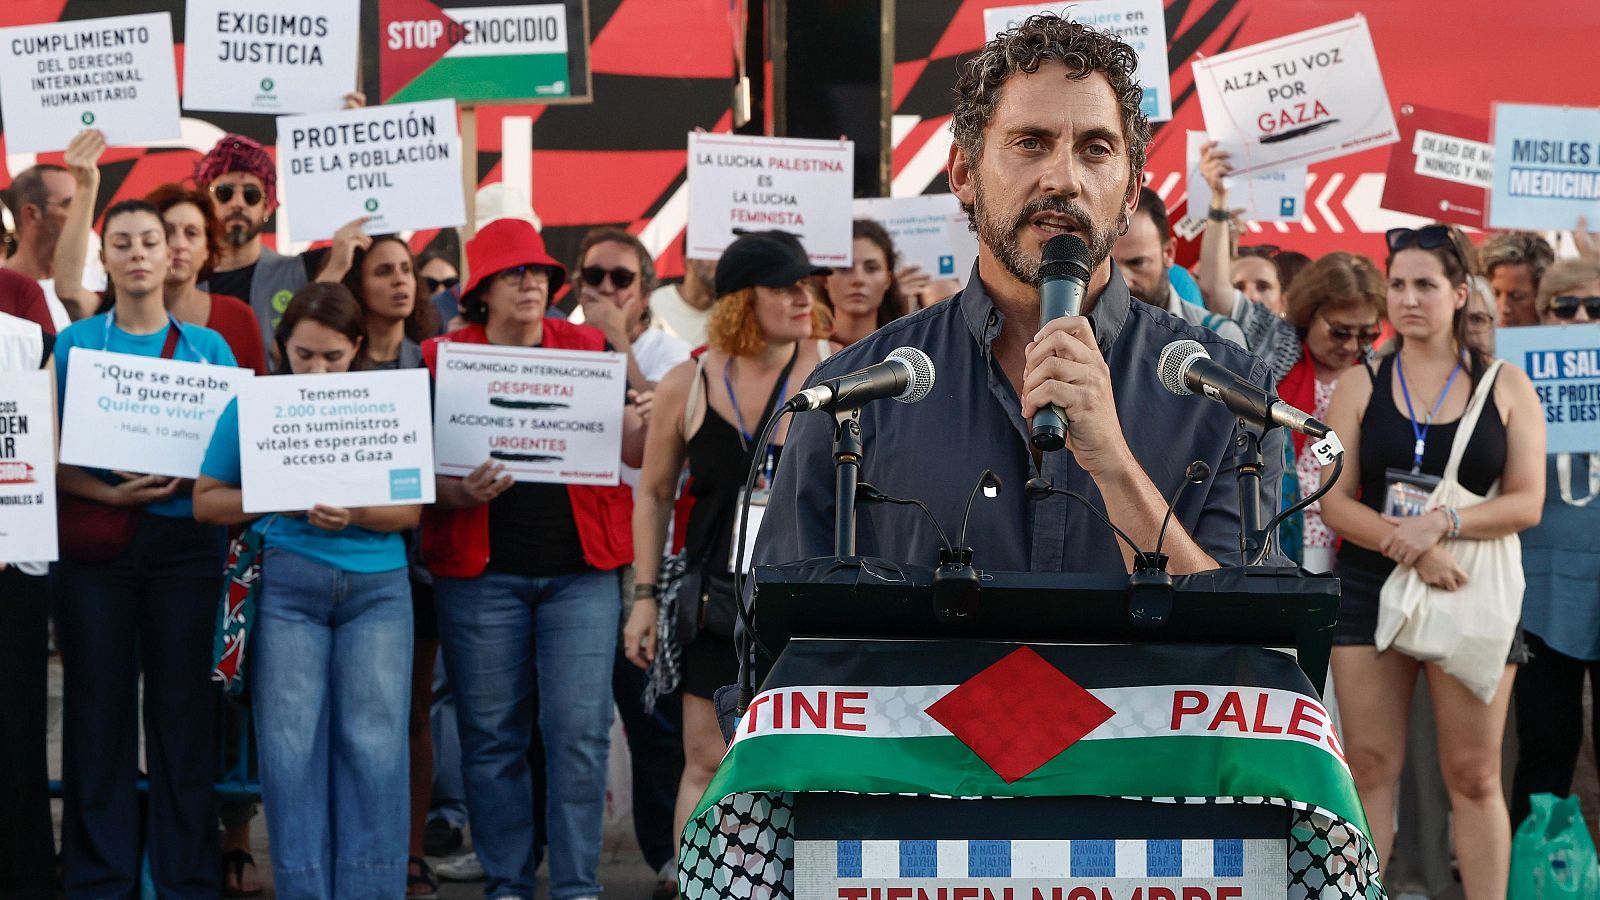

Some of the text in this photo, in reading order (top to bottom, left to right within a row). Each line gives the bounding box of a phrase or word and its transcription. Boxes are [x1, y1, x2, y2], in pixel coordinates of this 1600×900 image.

[217, 12, 328, 37] EXIGIMOS
[1126, 10, 1144, 20] en
[12, 26, 149, 56] CUMPLIMIENTO
[388, 16, 558, 50] STOP GENOCIDIO
[37, 52, 133, 73] DEL DERECHO
[218, 41, 323, 66] JUSTICIA
[31, 68, 143, 91] INTERNACIONAL
[1223, 48, 1344, 93] ALZA TU VOZ
[40, 86, 137, 108] HUMANITARIO
[1268, 81, 1307, 103] POR
[1258, 100, 1330, 133] GAZA
[293, 110, 436, 150] PROTECCIÓN
[291, 139, 449, 174] DE LA POBLACIÓN
[1462, 146, 1476, 160] DE
[1512, 140, 1590, 164] MISILES
[696, 153, 844, 173] LA LUCHA PALESTINA
[347, 172, 393, 190] CIVIL
[757, 175, 774, 188] ES
[732, 191, 798, 206] LA LUCHA
[730, 208, 804, 226] FEMINISTA
[447, 360, 614, 380] COMUNIDAD INTERNACIONAL
[1532, 352, 1558, 379] LA
[151, 372, 169, 384] se
[176, 376, 229, 391] acabe
[488, 381, 574, 398] ¡DESPIERTA!
[116, 382, 205, 404] la guerra!
[300, 388, 370, 401] Tenemos
[98, 396, 160, 416] Quiero
[274, 402, 396, 418] 2.000 camiones
[1547, 405, 1564, 422] SE
[156, 426, 168, 437] 10
[172, 429, 200, 440] años
[272, 417, 400, 434] con suministros
[450, 414, 605, 434] ACCIONES Y SANCIONES
[256, 430, 418, 450] vitales esperando el
[488, 436, 568, 452] URGENTES
[282, 448, 392, 466] acceso a Gaza
